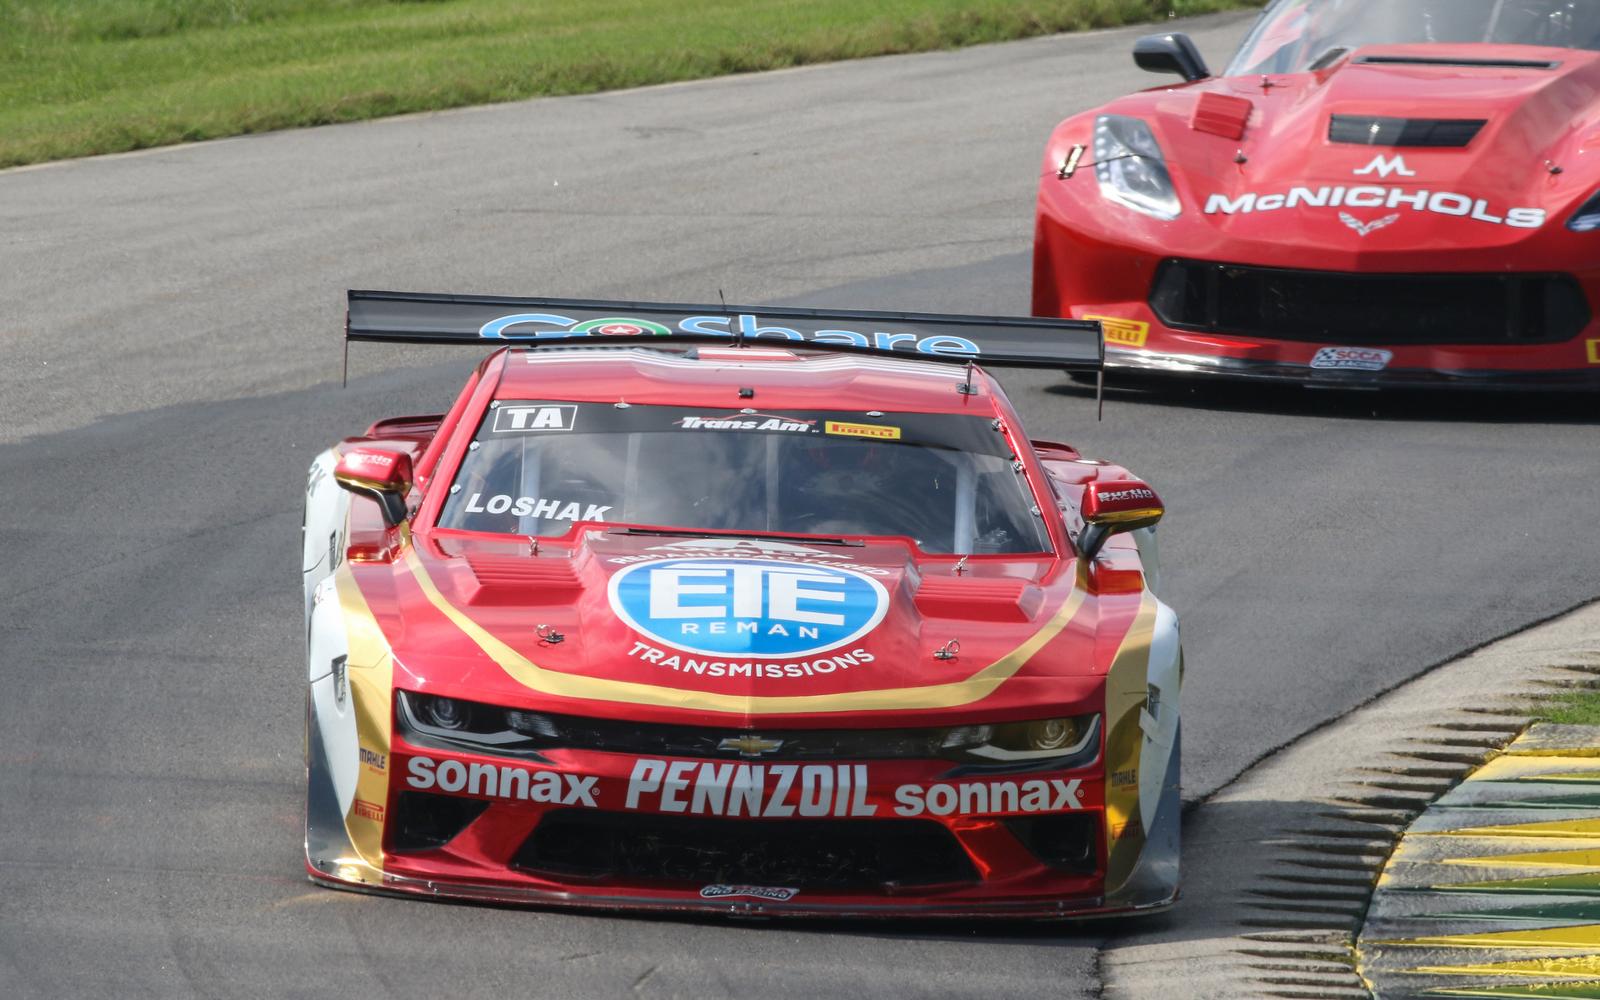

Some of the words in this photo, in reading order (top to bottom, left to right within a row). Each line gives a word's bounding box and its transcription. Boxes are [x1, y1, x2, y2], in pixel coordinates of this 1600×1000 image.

[1204, 185, 1547, 229] McNICHOLS
[1336, 350, 1383, 361] SCCA
[507, 407, 563, 429] TA
[681, 416, 757, 430] Trans
[759, 418, 809, 432] Am
[832, 423, 893, 438] PIRELLI
[464, 493, 614, 522] LOSHAK
[650, 562, 846, 626] ETE
[681, 621, 819, 640] REMAN
[627, 641, 875, 678] TRANSMISSIONS
[359, 748, 386, 770] MAHLE
[625, 758, 878, 817] PENNZOIL
